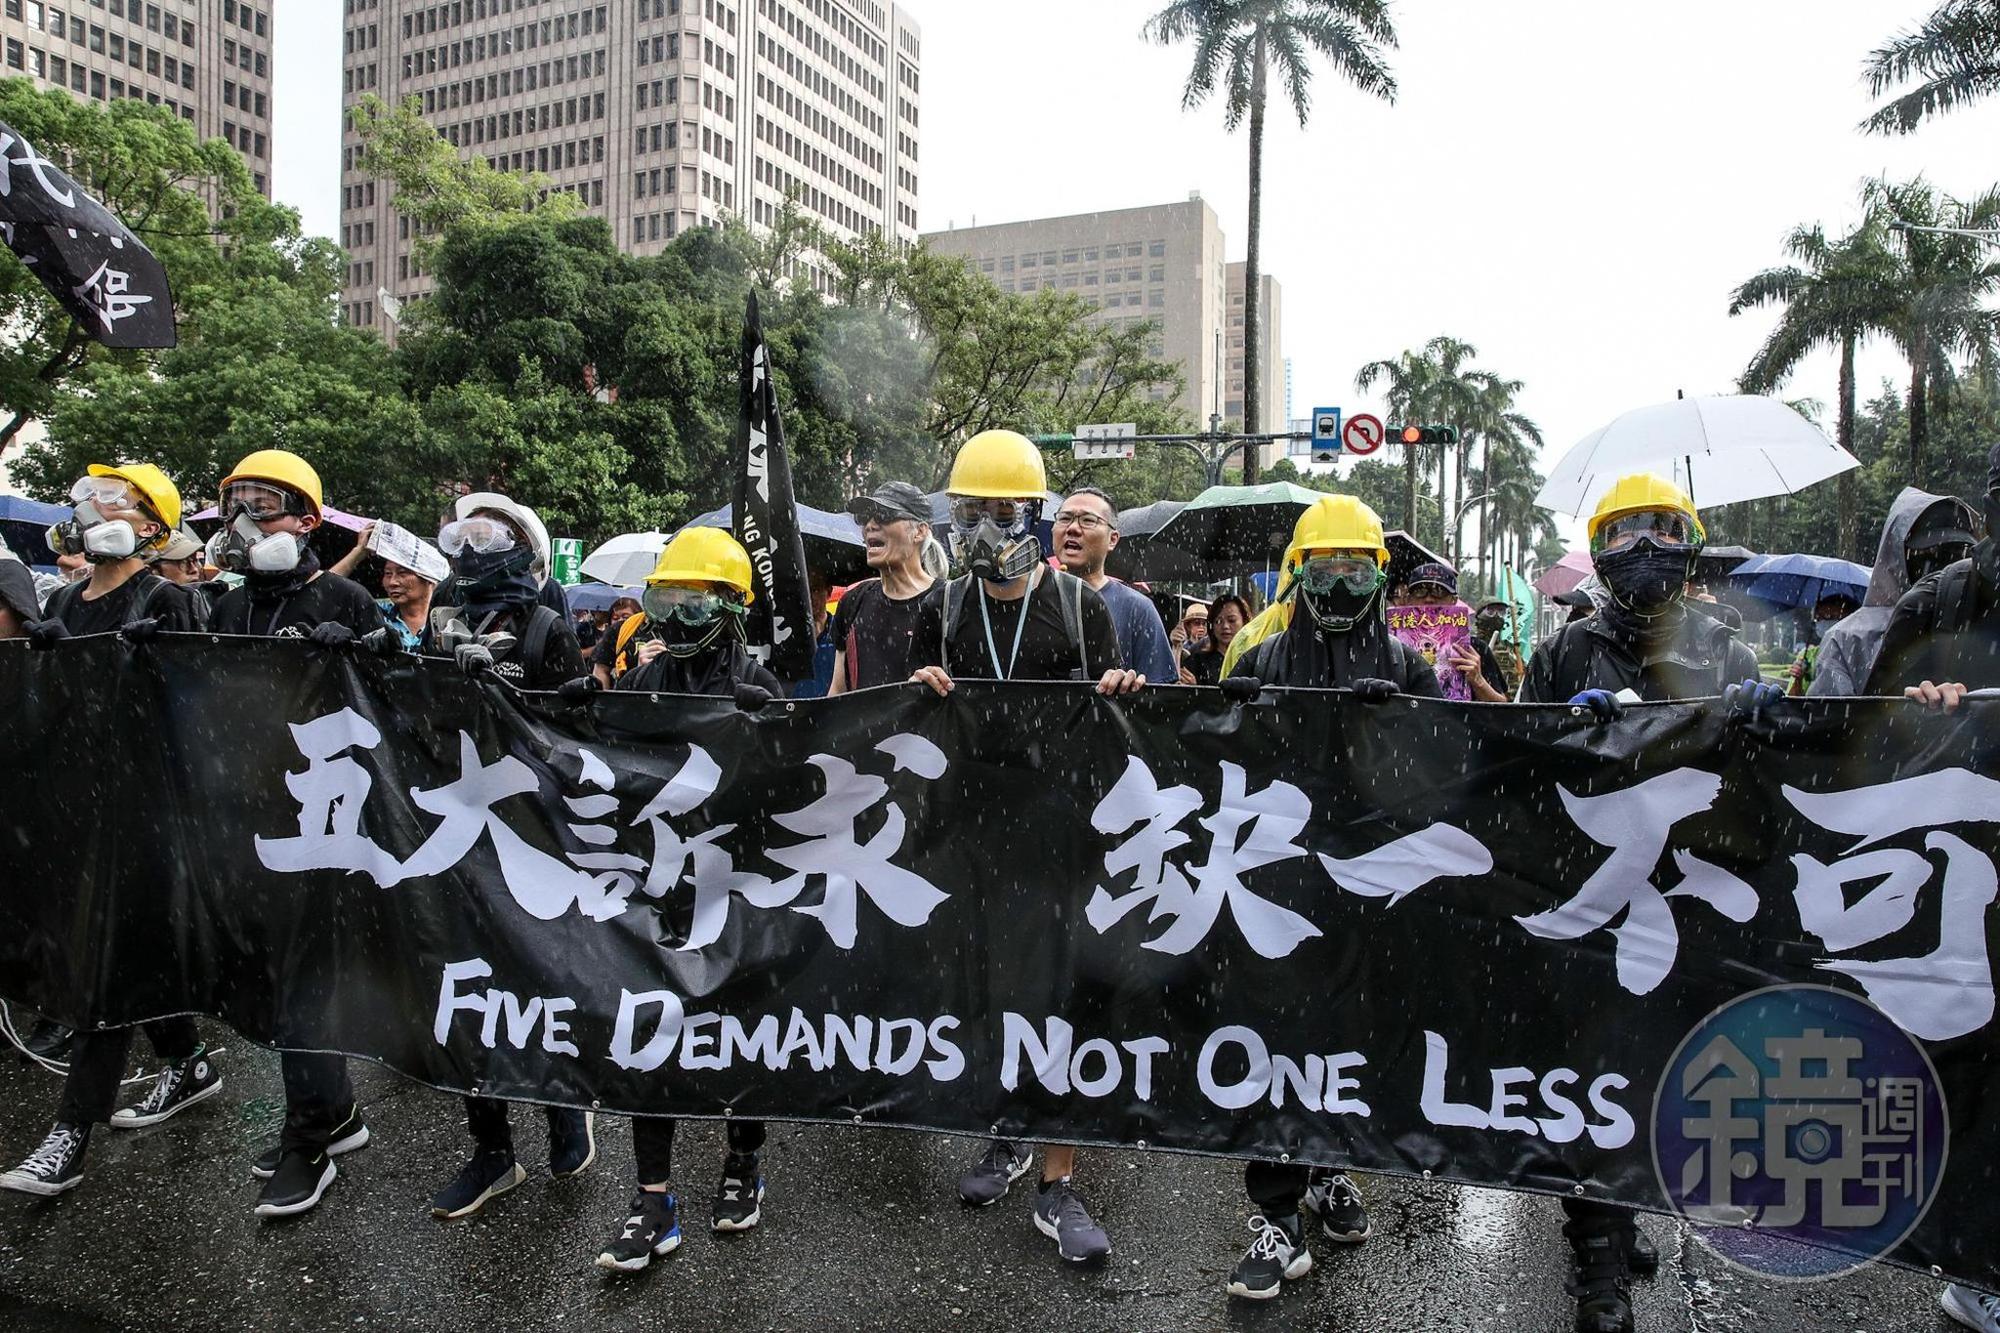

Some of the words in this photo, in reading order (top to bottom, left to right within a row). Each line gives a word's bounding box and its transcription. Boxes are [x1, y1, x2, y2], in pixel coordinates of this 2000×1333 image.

[1389, 612, 1468, 629] 香港人加油
[255, 707, 951, 951] 五大訴求
[1085, 755, 2000, 1040] 缺一不可
